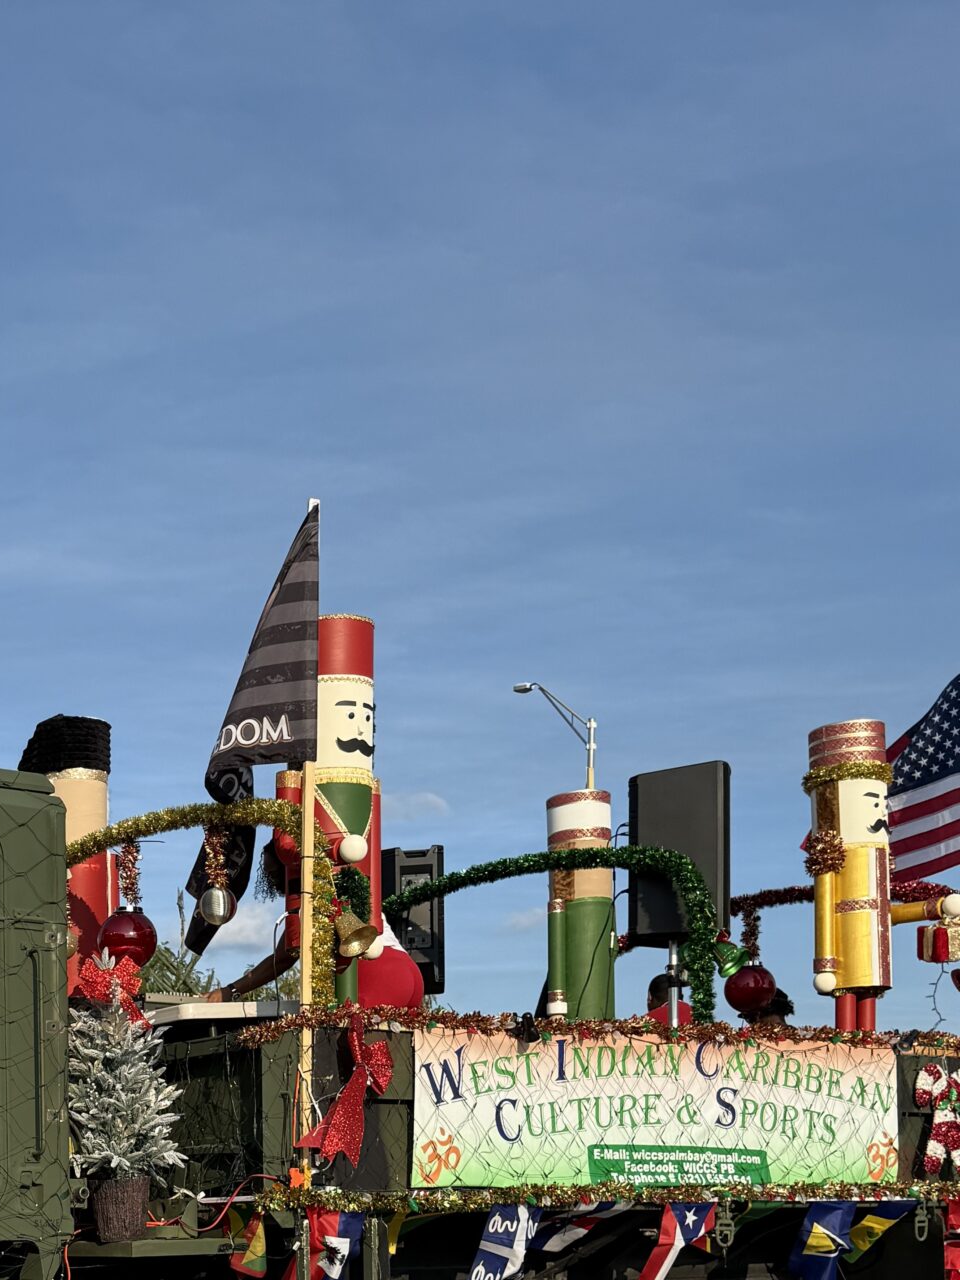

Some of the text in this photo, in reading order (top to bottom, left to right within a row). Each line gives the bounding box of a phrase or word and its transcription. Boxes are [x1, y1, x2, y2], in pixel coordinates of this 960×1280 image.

[421, 1039, 893, 1114] WEST INDIAN CARIBBEAN
[495, 1086, 839, 1146] CULTURE & SPORTS
[624, 1161, 735, 1174] Facebook: WICCS PB
[632, 1151, 761, 1165] wiccspalmbay@gmail.com
